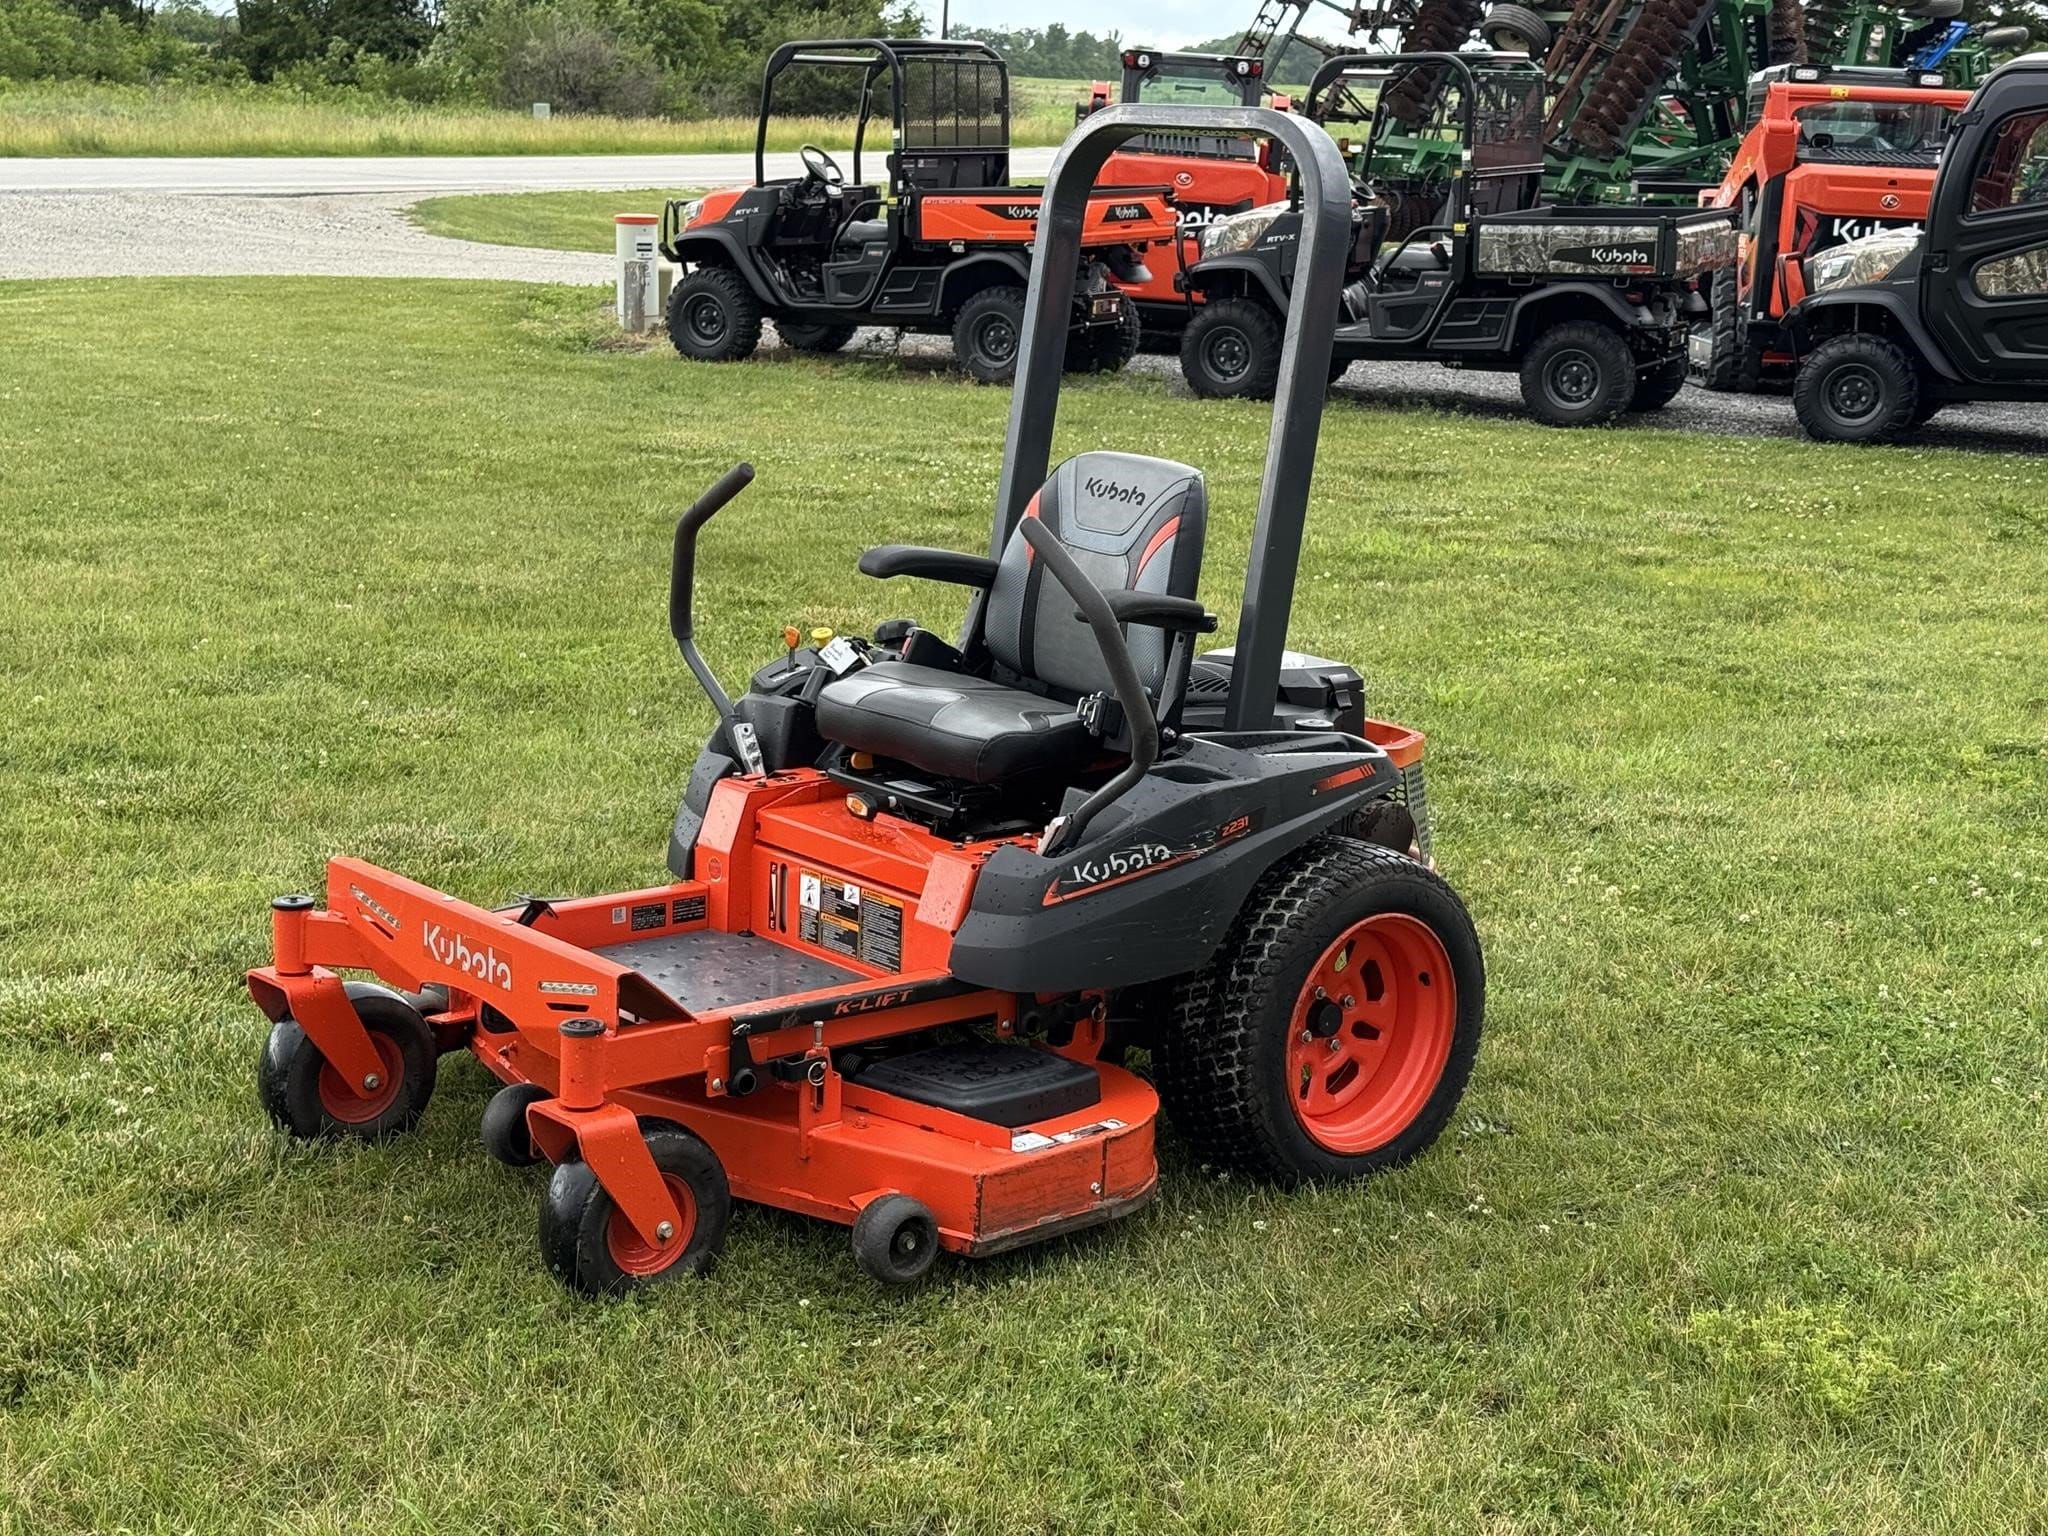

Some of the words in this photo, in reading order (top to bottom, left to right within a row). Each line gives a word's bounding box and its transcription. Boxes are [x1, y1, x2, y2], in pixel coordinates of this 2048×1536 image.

[1008, 206, 1039, 218] Kubo
[1267, 234, 1296, 243] RTV-X
[1591, 248, 1648, 264] Kubota
[1084, 477, 1146, 506] Kubota
[1073, 844, 1171, 883] Kubota
[423, 920, 512, 992] Kubota
[834, 989, 914, 1016] K-LIFT
